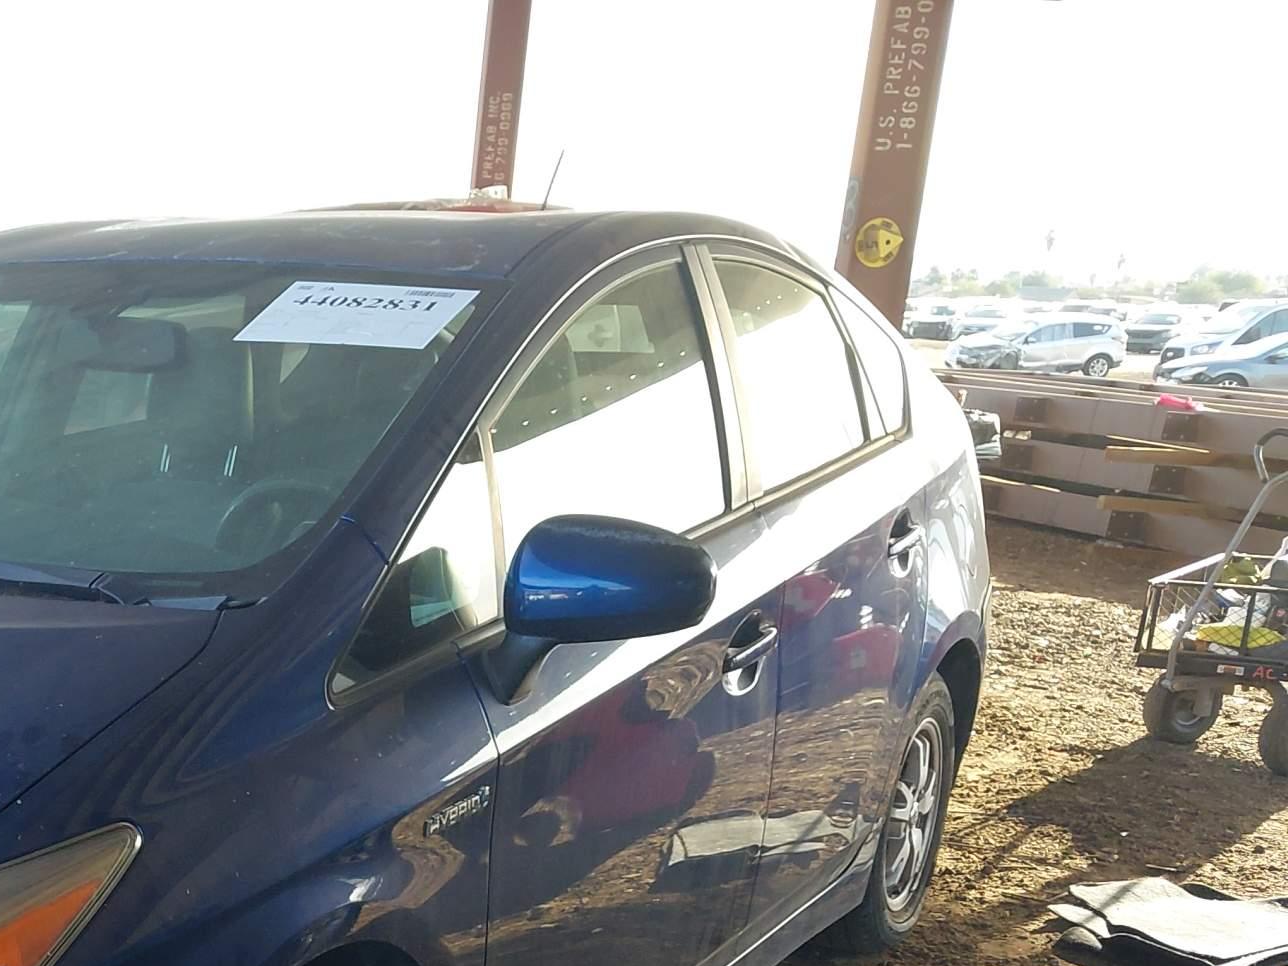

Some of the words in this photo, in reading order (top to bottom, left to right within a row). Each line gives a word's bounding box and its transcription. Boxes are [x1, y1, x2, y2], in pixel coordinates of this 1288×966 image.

[883, 5, 913, 95] PREFAB
[874, 108, 897, 151] U.S.
[481, 125, 497, 179] PREFAB
[293, 294, 439, 312] 44082831
[425, 794, 481, 836] HYBRID
